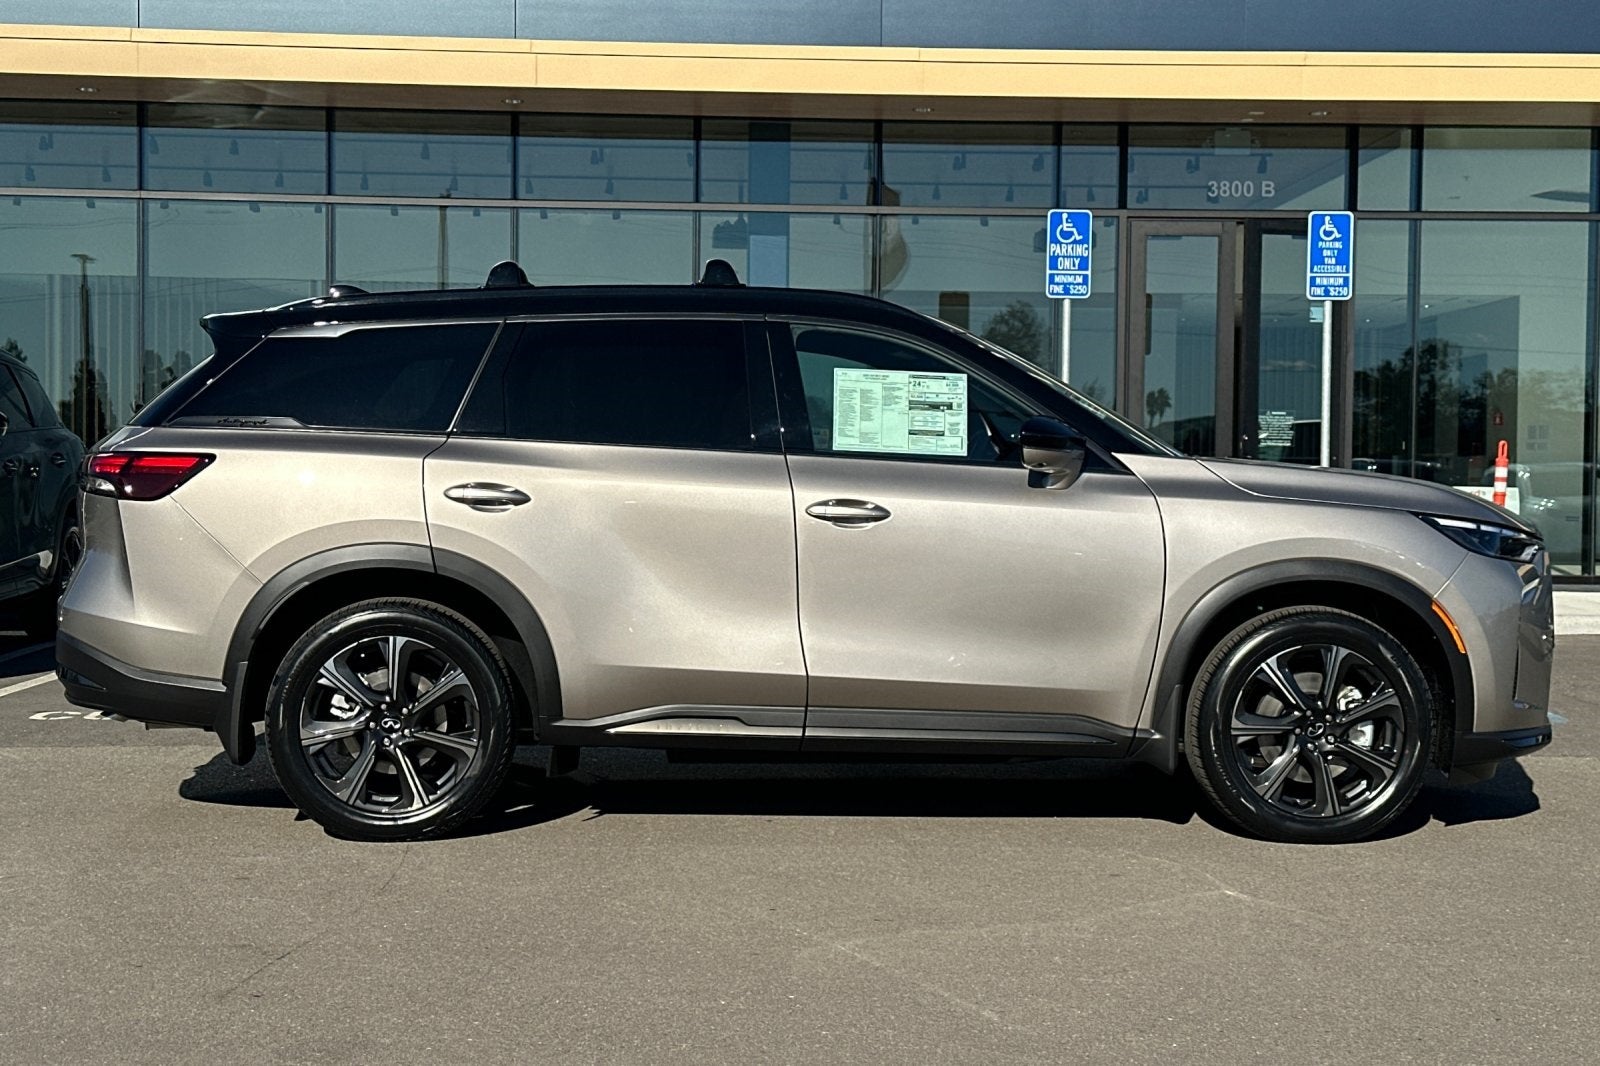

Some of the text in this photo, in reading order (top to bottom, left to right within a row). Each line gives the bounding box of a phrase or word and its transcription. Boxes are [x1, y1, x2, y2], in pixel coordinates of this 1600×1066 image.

[1207, 180, 1275, 197] 3800 B
[1318, 241, 1343, 249] PARKING
[1050, 243, 1088, 257] PARKING
[1322, 249, 1338, 257] ONLY
[1057, 257, 1081, 270] ONLY
[1313, 265, 1347, 273] ACCESSIBLE
[1054, 275, 1083, 284] MINIMUM
[1315, 277, 1344, 286] MINIMUM
[1049, 284, 1065, 294] FINE
[1310, 286, 1325, 296] FINE
